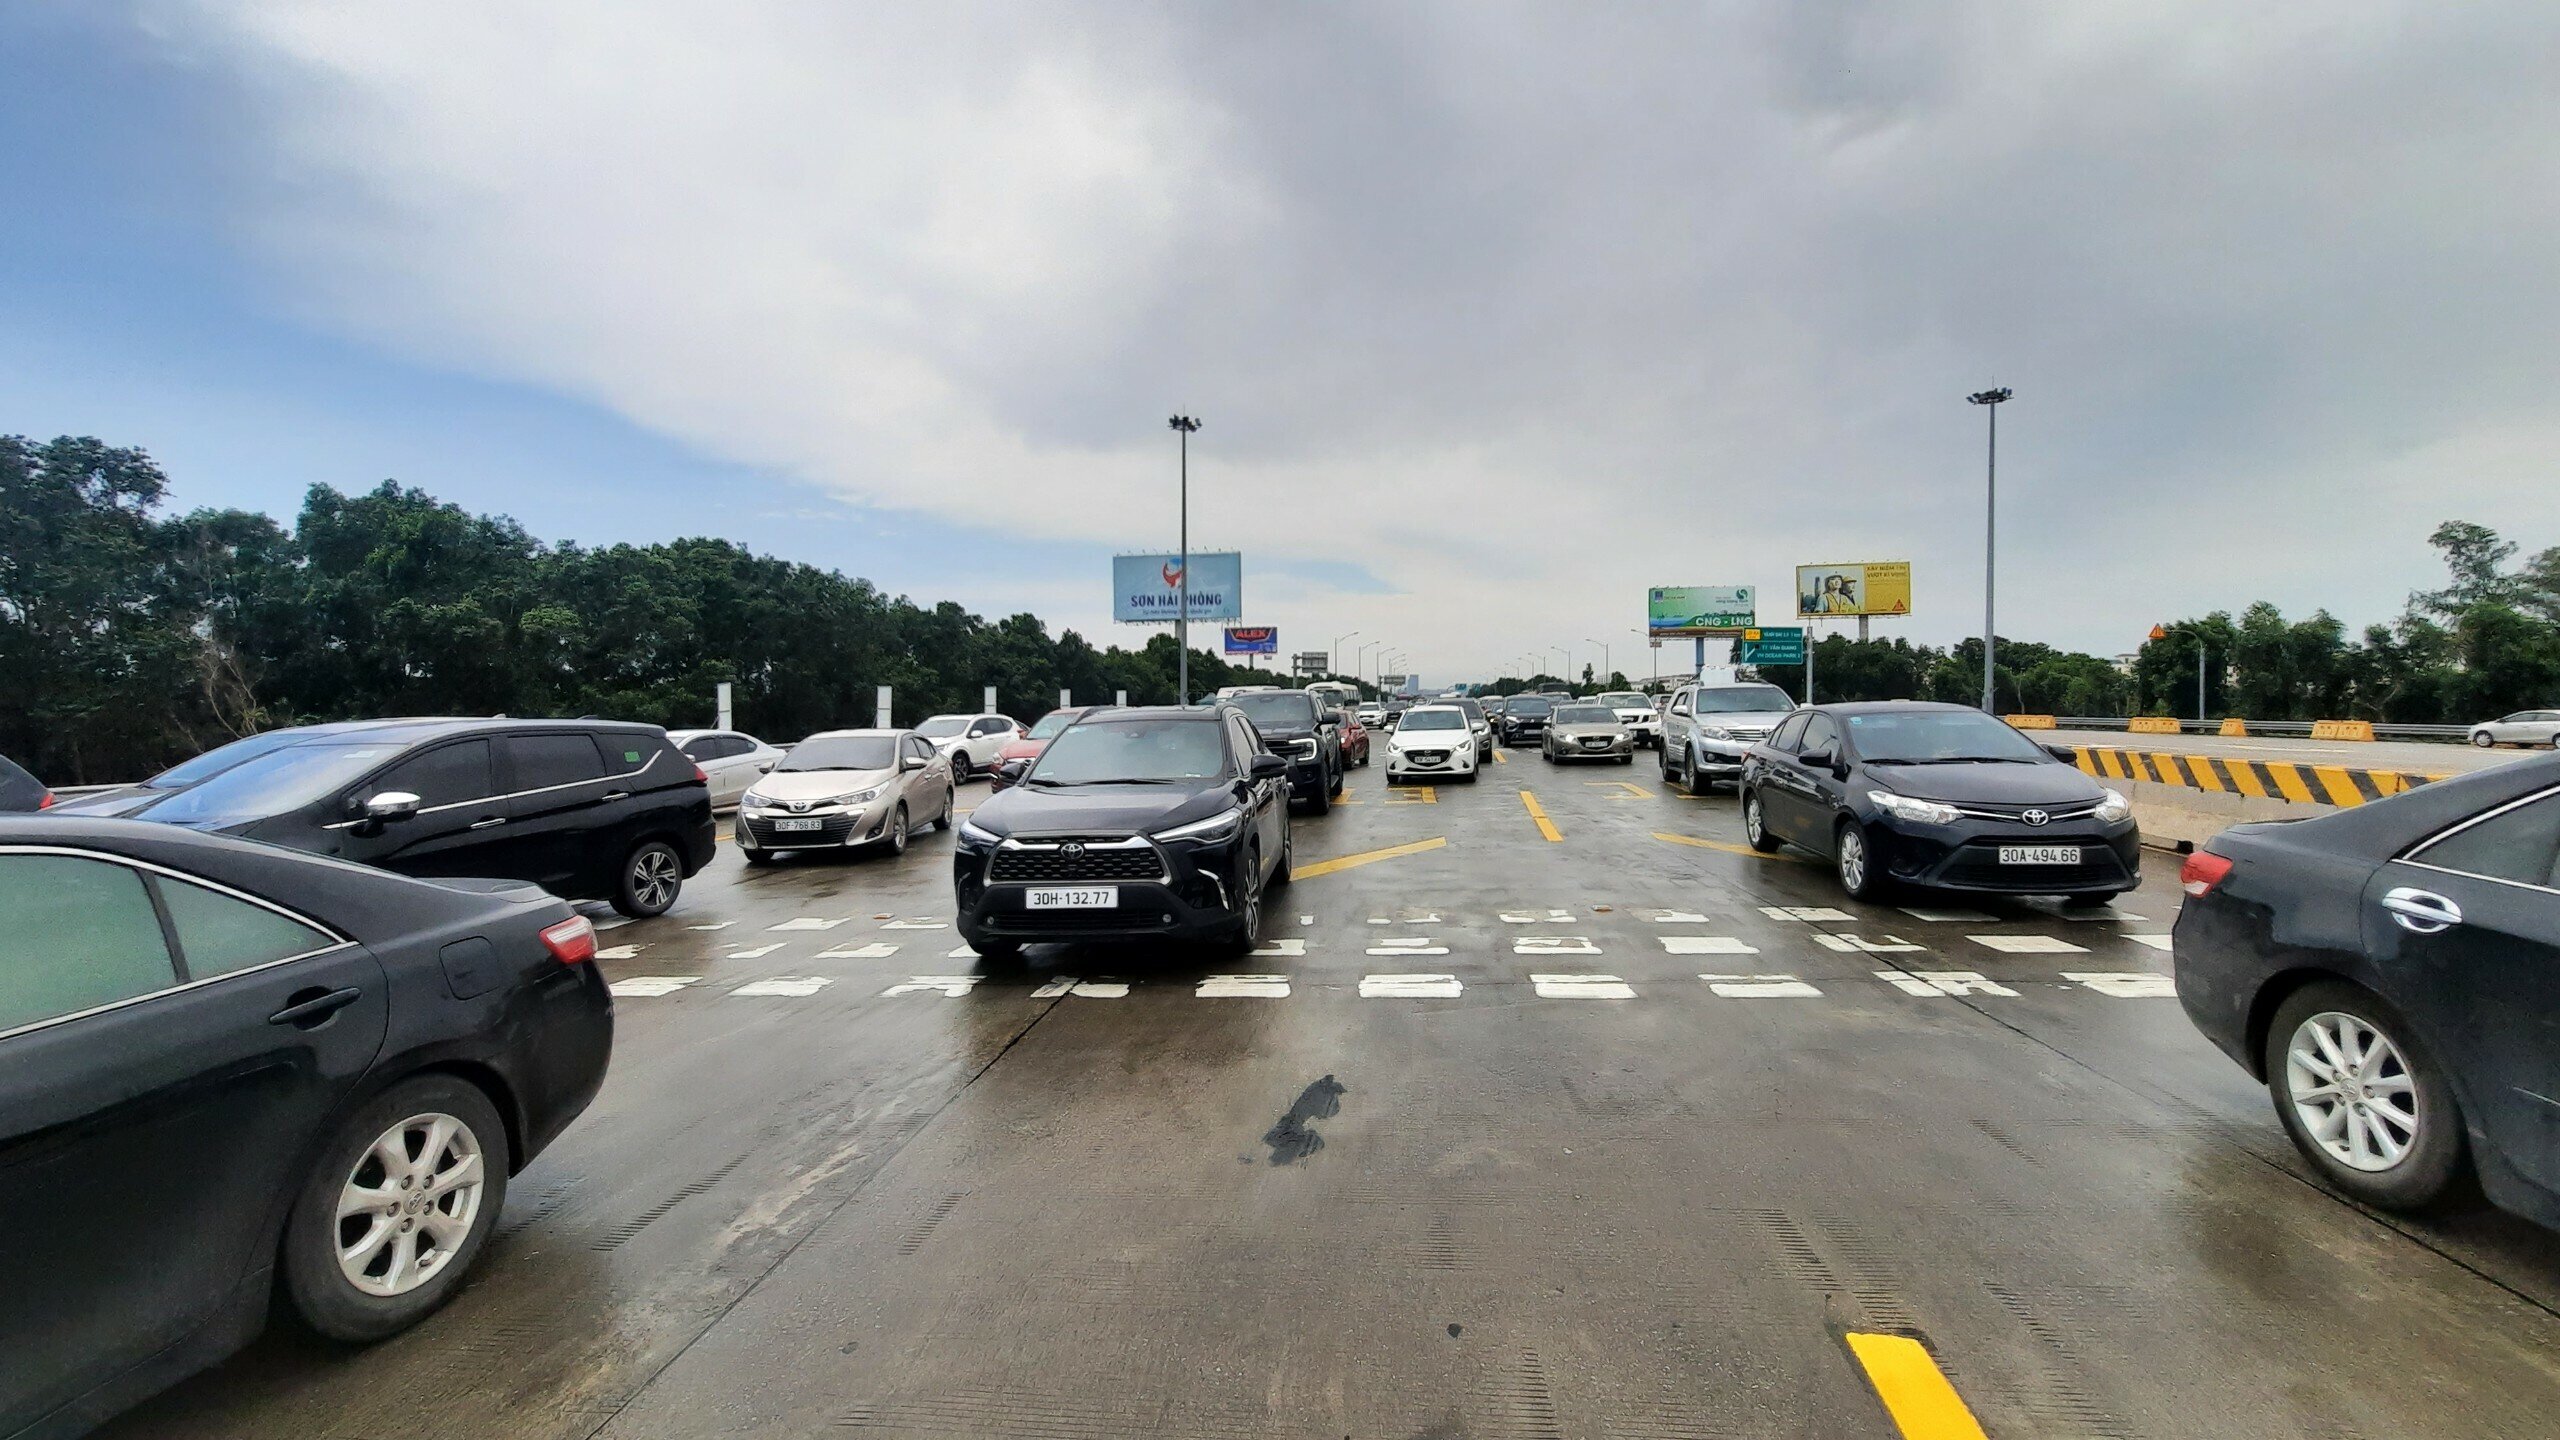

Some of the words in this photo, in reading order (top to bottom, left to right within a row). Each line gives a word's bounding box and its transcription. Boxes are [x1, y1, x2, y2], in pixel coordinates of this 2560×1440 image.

[1131, 595, 1154, 607] SƠN
[1159, 591, 1178, 606] HẢI
[1695, 617, 1721, 626] CNG
[1731, 616, 1753, 626] LNG
[1235, 629, 1267, 638] ALEX
[2002, 849, 2078, 862] 30A-494.66
[1033, 891, 1109, 905] 30H-132.77
